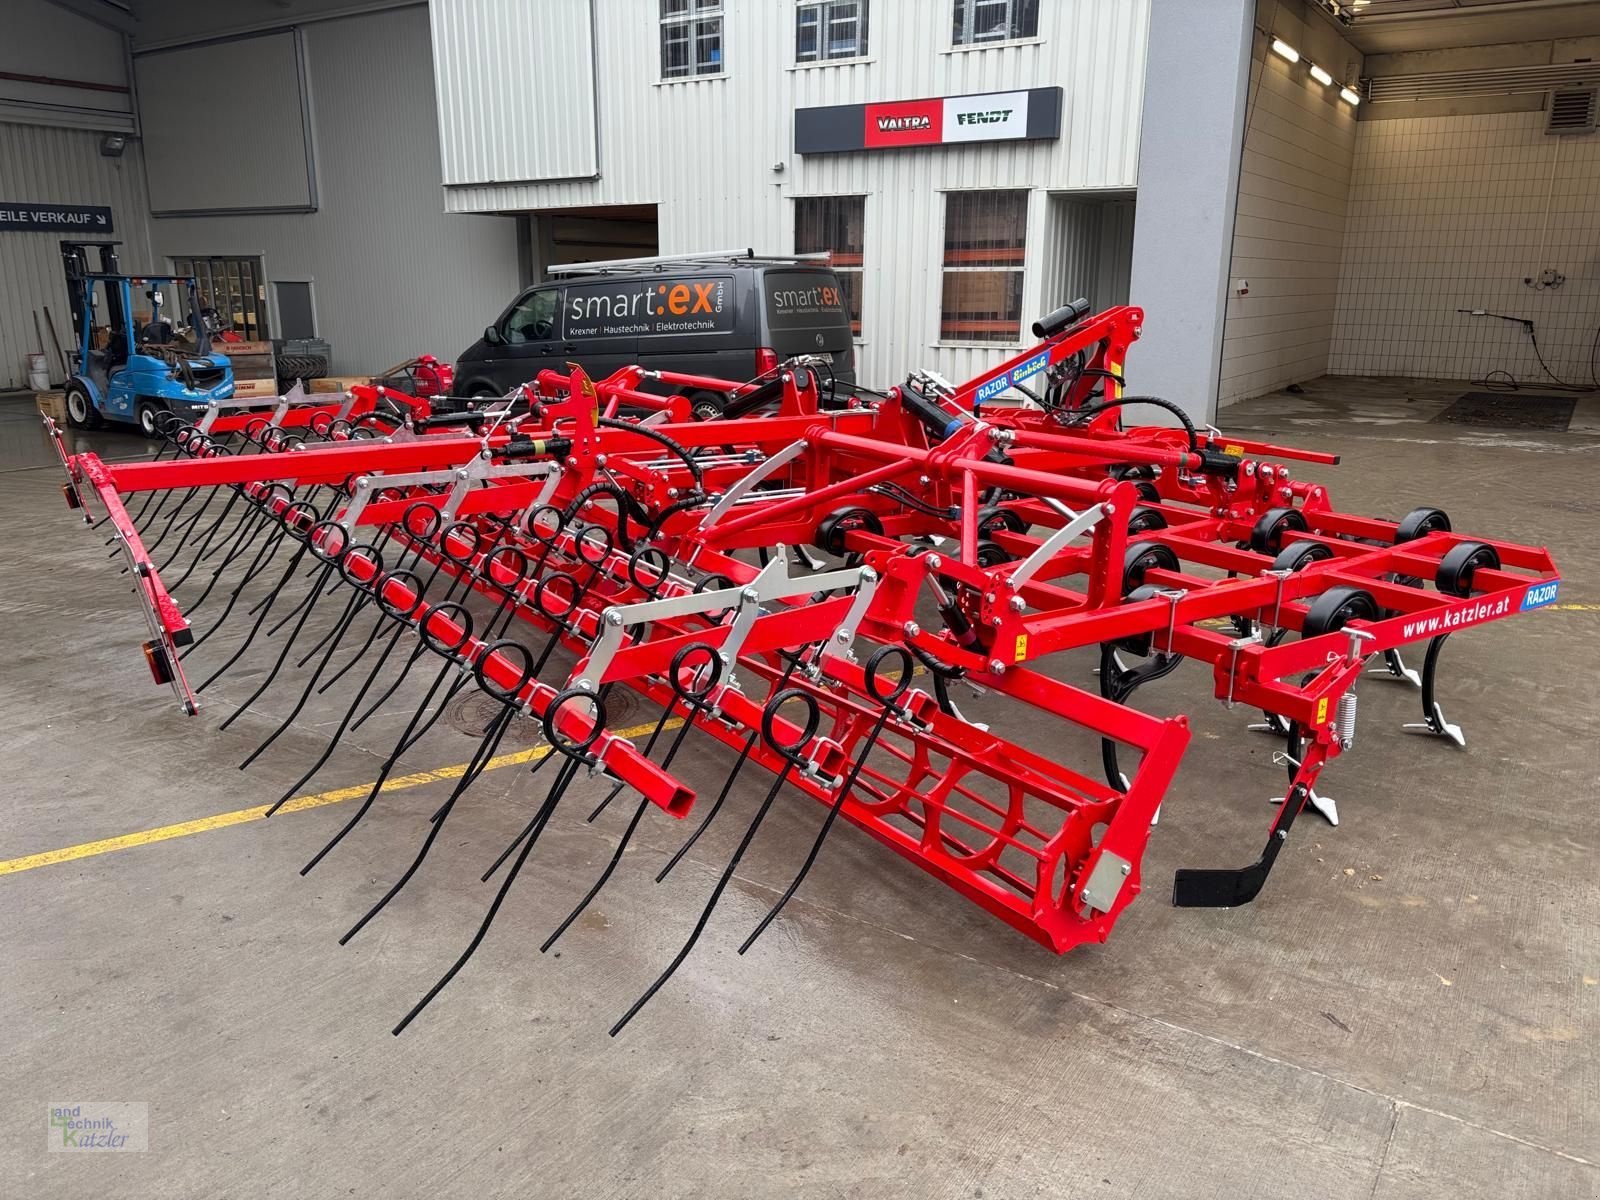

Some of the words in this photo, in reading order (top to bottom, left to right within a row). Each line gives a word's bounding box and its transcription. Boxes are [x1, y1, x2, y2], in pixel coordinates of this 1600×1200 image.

[877, 116, 931, 132] VALTRA
[956, 109, 1013, 126] FENDT
[0, 211, 28, 222] EILE
[30, 212, 92, 224] VERKAUF
[571, 282, 715, 320] smart:ex
[715, 281, 724, 313] GmbH
[569, 327, 598, 336] Krexner
[603, 324, 650, 335] Haustechnik
[656, 320, 715, 332] Elektrotechnik
[978, 377, 1008, 401] RAZOR
[1403, 596, 1510, 638] www.katzler.at
[1526, 585, 1558, 606] RAZOR
